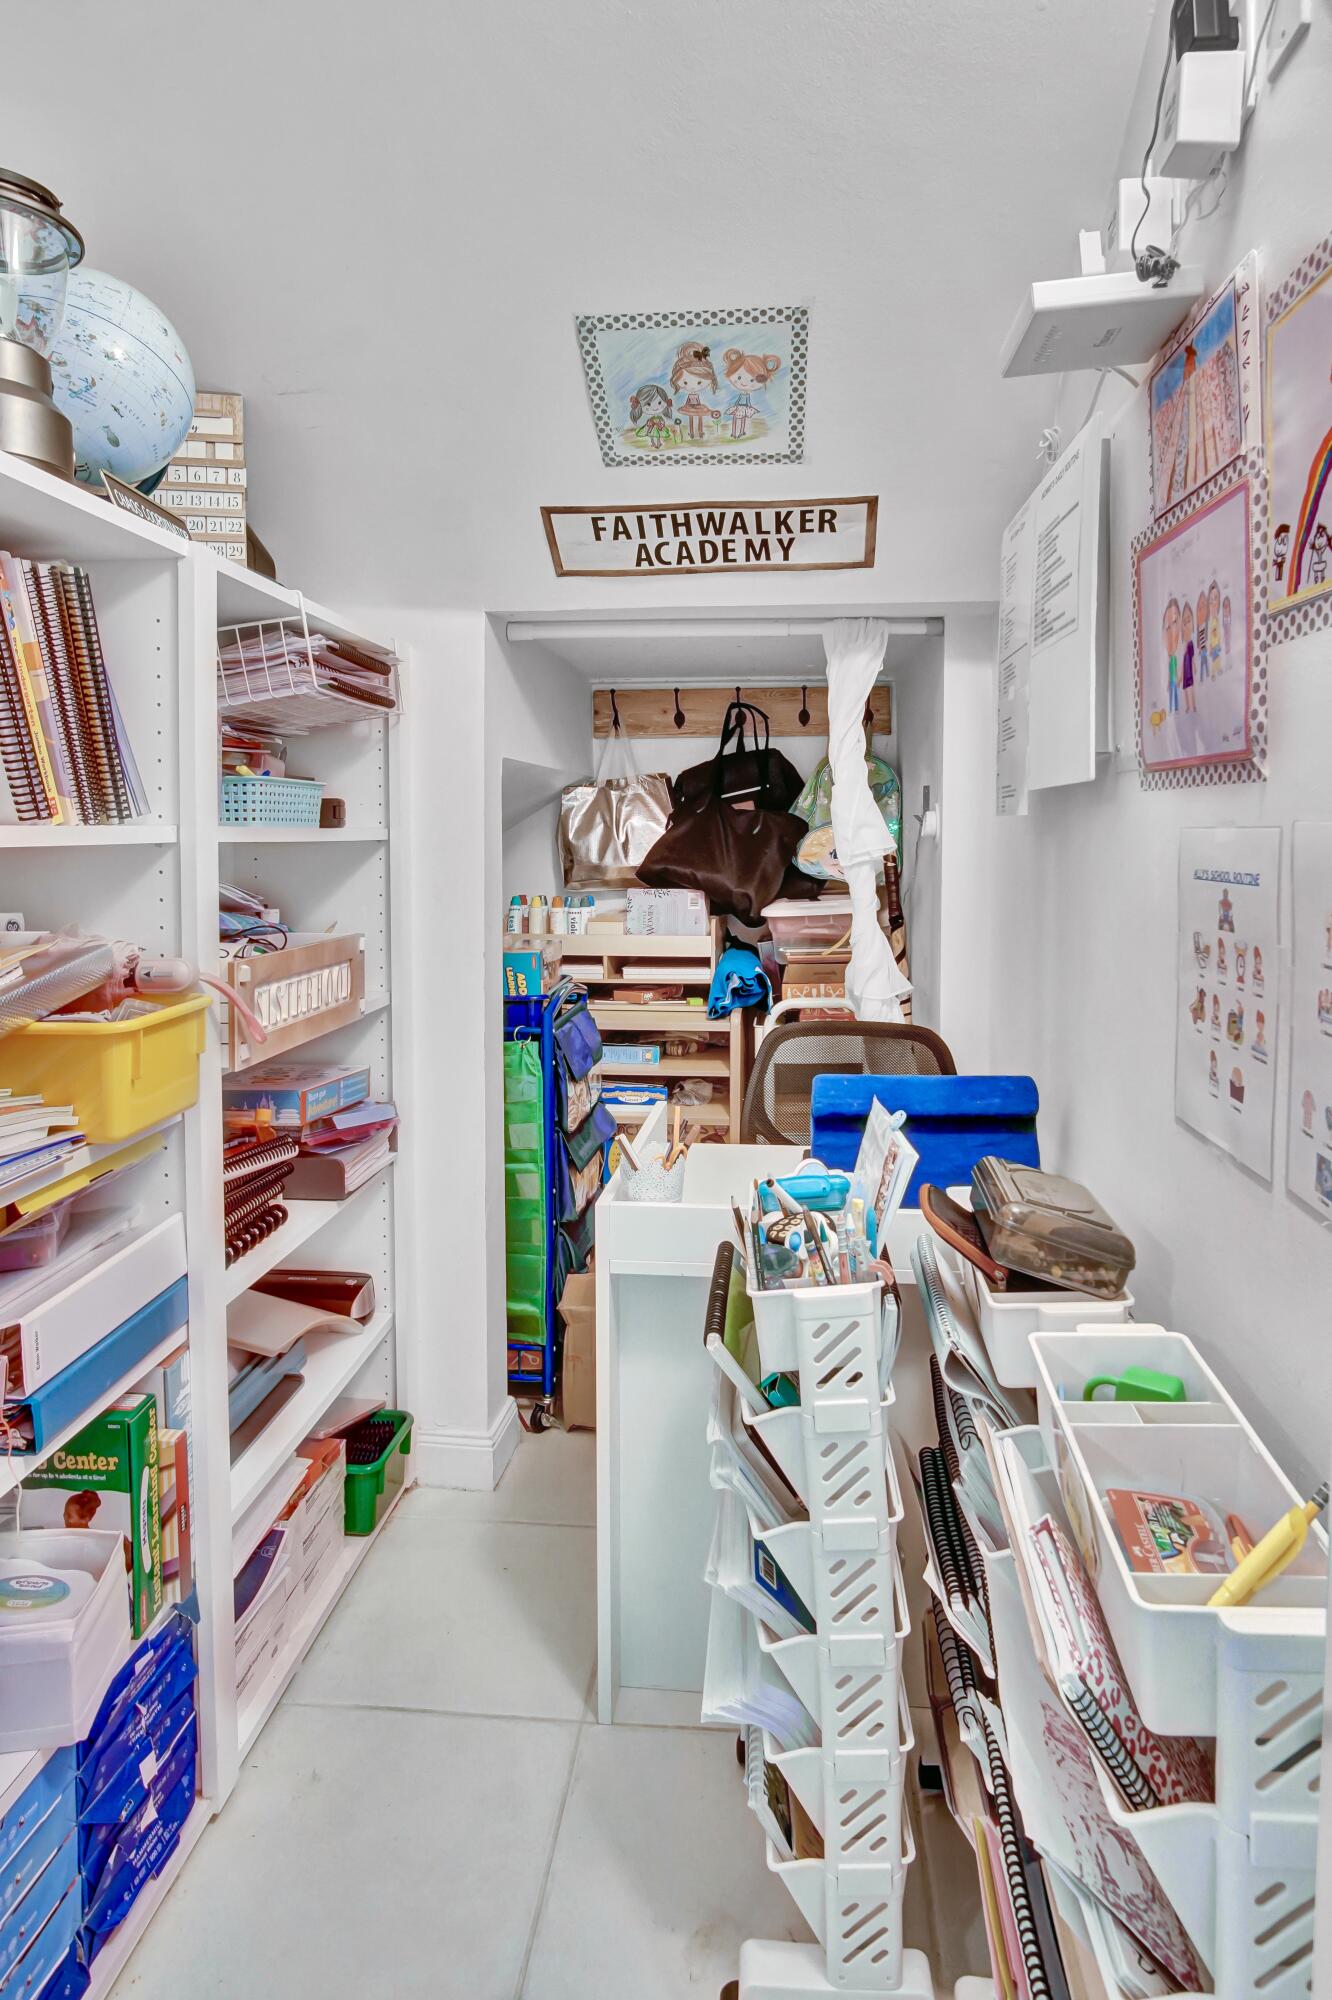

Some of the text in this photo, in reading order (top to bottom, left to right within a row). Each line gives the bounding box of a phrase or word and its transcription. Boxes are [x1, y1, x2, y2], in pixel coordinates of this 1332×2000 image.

[173, 469, 241, 483] 5 6 7 8
[171, 494, 183, 506] 12
[190, 495, 202, 506] 13
[208, 496, 221, 507] 14
[227, 496, 239, 508] 15
[188, 519, 243, 533] 20 21 22
[590, 508, 839, 543] FAITHWALKER
[228, 544, 243, 557] 29
[634, 537, 797, 567] ACADEMY
[53, 1450, 119, 1472] Center
[148, 1407, 164, 1612] Instant Learning Center
[132, 1819, 163, 1867] HAMMERMILL
